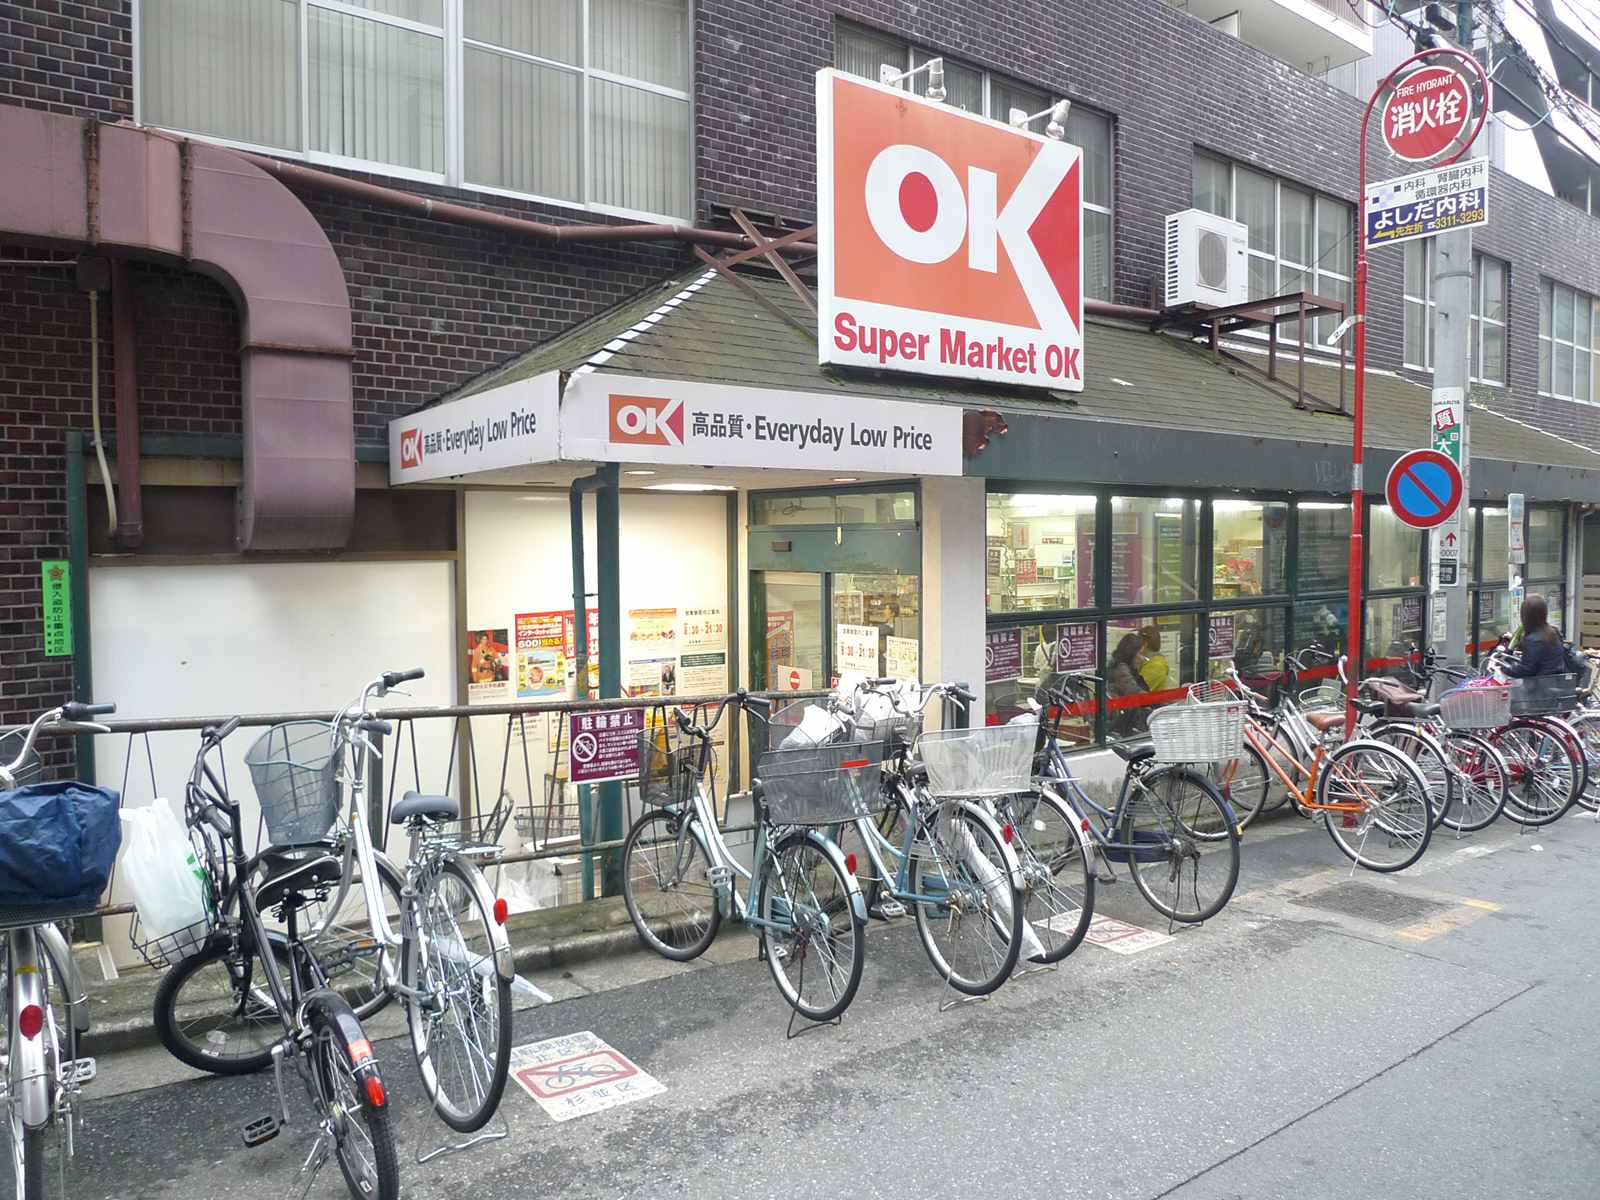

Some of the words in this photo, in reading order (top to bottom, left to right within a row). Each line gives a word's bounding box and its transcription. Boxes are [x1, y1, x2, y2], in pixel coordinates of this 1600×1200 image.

[1396, 86, 1415, 98] FIRE
[1416, 74, 1454, 94] HYDRANT
[1391, 88, 1463, 139] 消火栓
[1403, 177, 1426, 193] 内科
[1374, 189, 1481, 230] よしだ内科
[1435, 208, 1484, 229] 3311-3293
[864, 140, 1080, 336] OK
[833, 311, 930, 364] Super
[939, 327, 1037, 374] Market
[1044, 343, 1081, 381] OK
[487, 418, 508, 442] Low
[510, 408, 537, 437] Price
[616, 399, 683, 446] OK
[849, 418, 887, 448] Low
[892, 425, 932, 451] Price
[1437, 409, 1454, 430] 質
[403, 428, 423, 466] OK
[581, 712, 634, 730] 駐輪禁止
[565, 1082, 637, 1107] 杉並区
